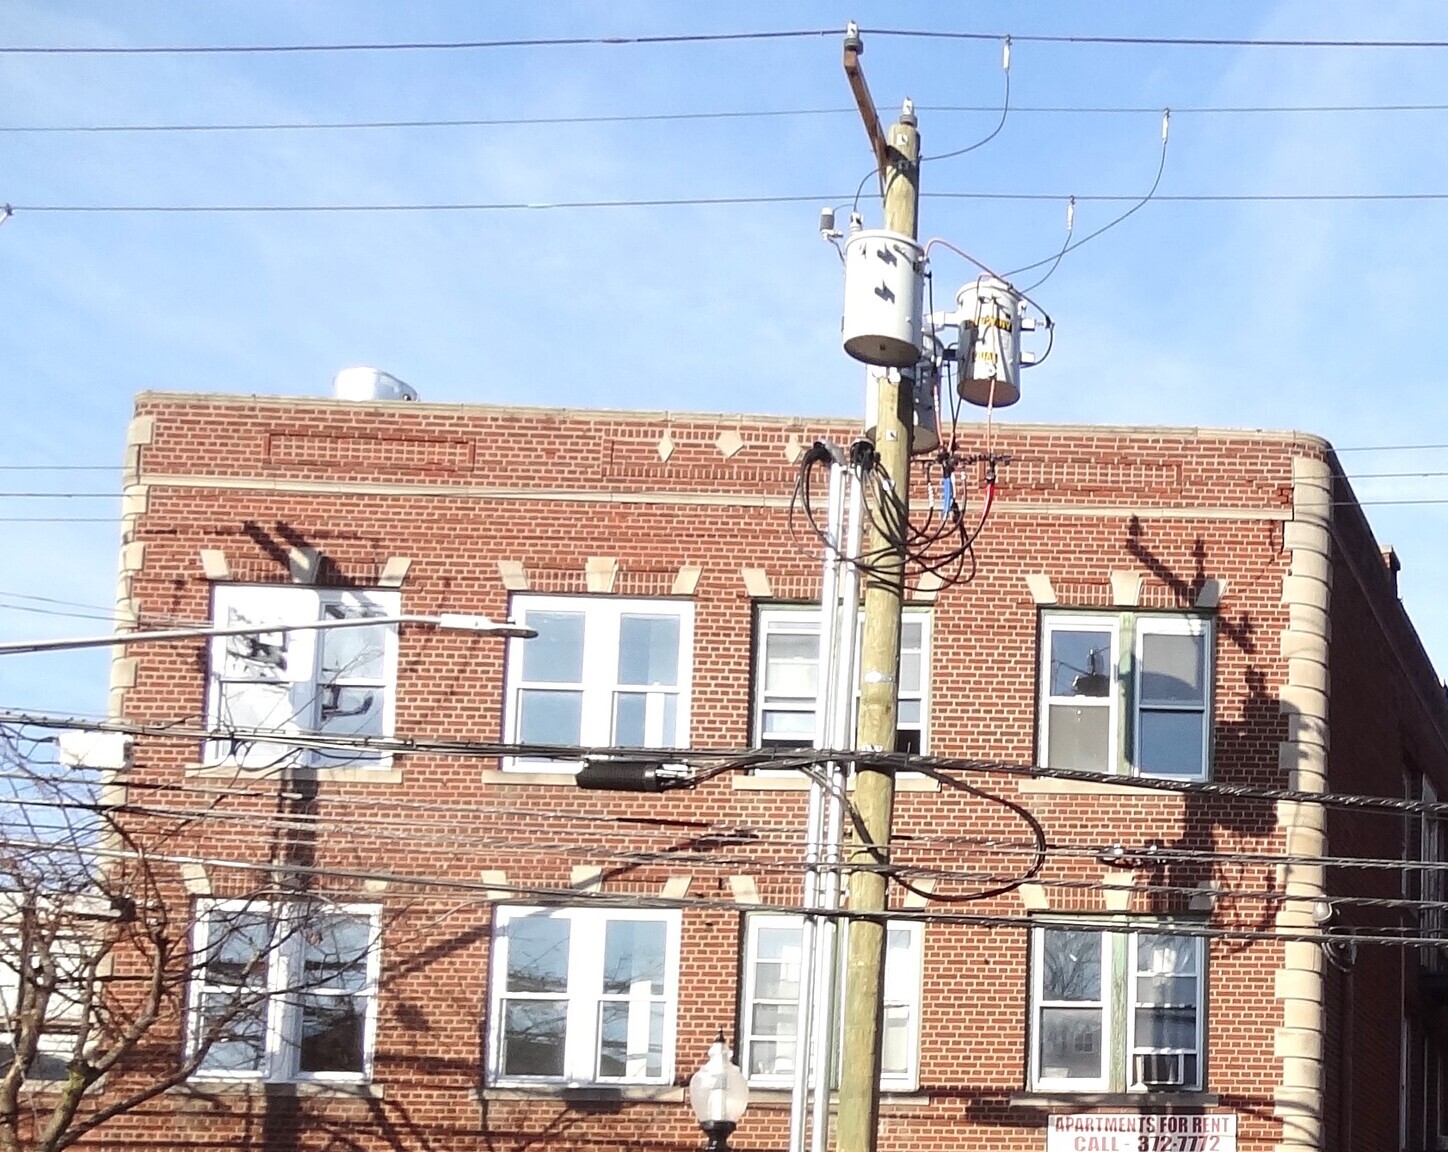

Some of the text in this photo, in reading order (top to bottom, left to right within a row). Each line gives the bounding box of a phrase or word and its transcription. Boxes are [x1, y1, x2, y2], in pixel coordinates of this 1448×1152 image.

[1055, 1116, 1230, 1133] APARTMENTS FOR RENT
[1073, 1136, 1119, 1152] CALL
[1137, 1135, 1221, 1152] 372-7772
